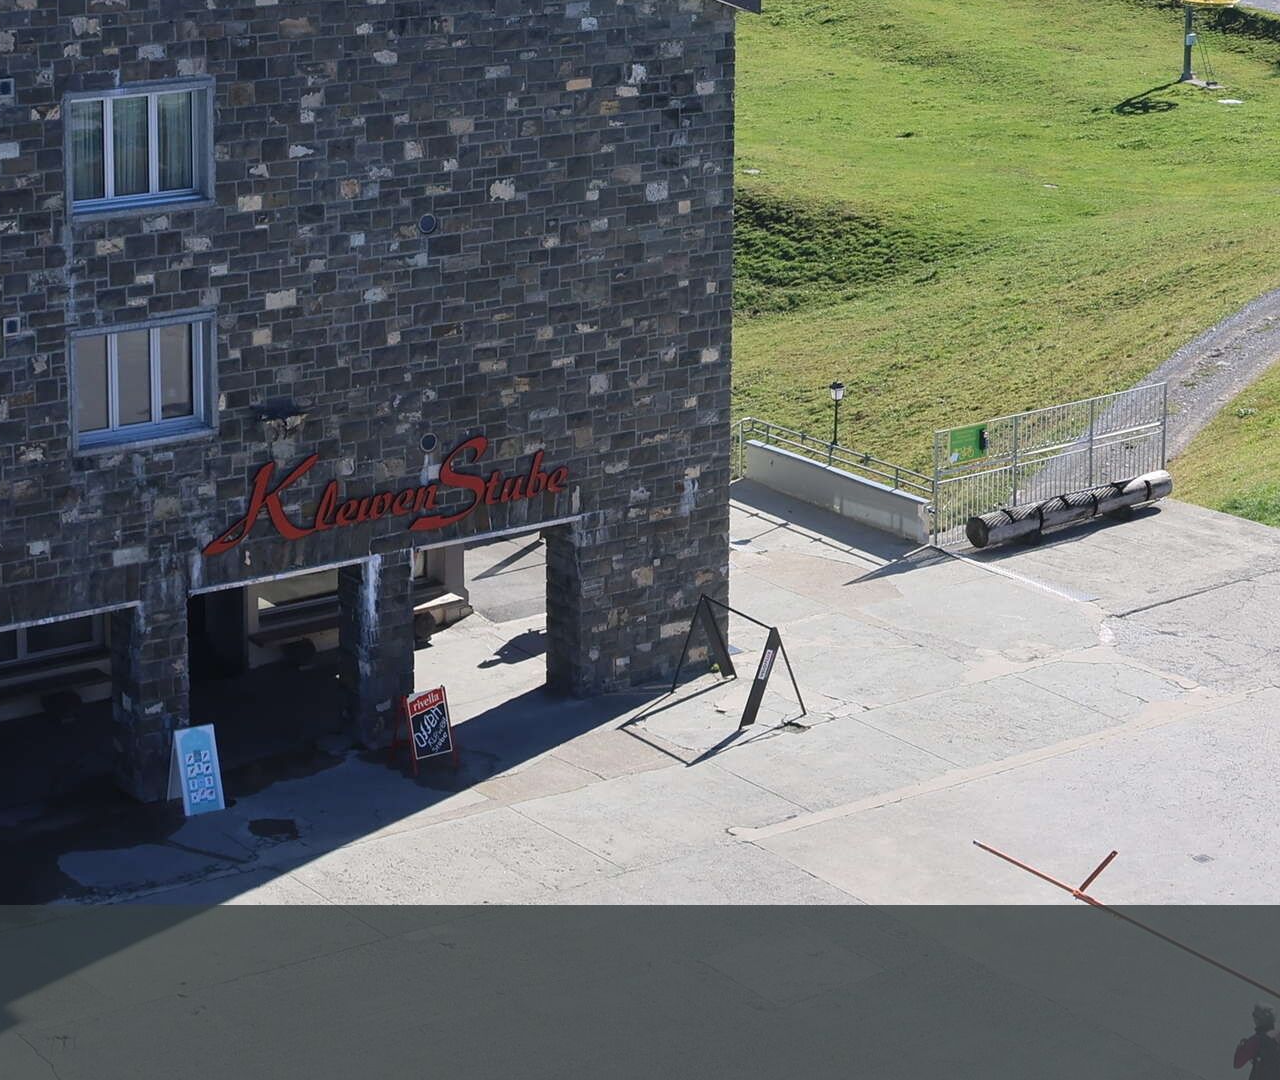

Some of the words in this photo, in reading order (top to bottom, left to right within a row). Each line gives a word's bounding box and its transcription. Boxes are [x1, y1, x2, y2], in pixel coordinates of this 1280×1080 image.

[201, 452, 439, 557] Klewen
[408, 434, 570, 534] Stube
[413, 692, 440, 711] rivella
[414, 706, 443, 748] Offen
